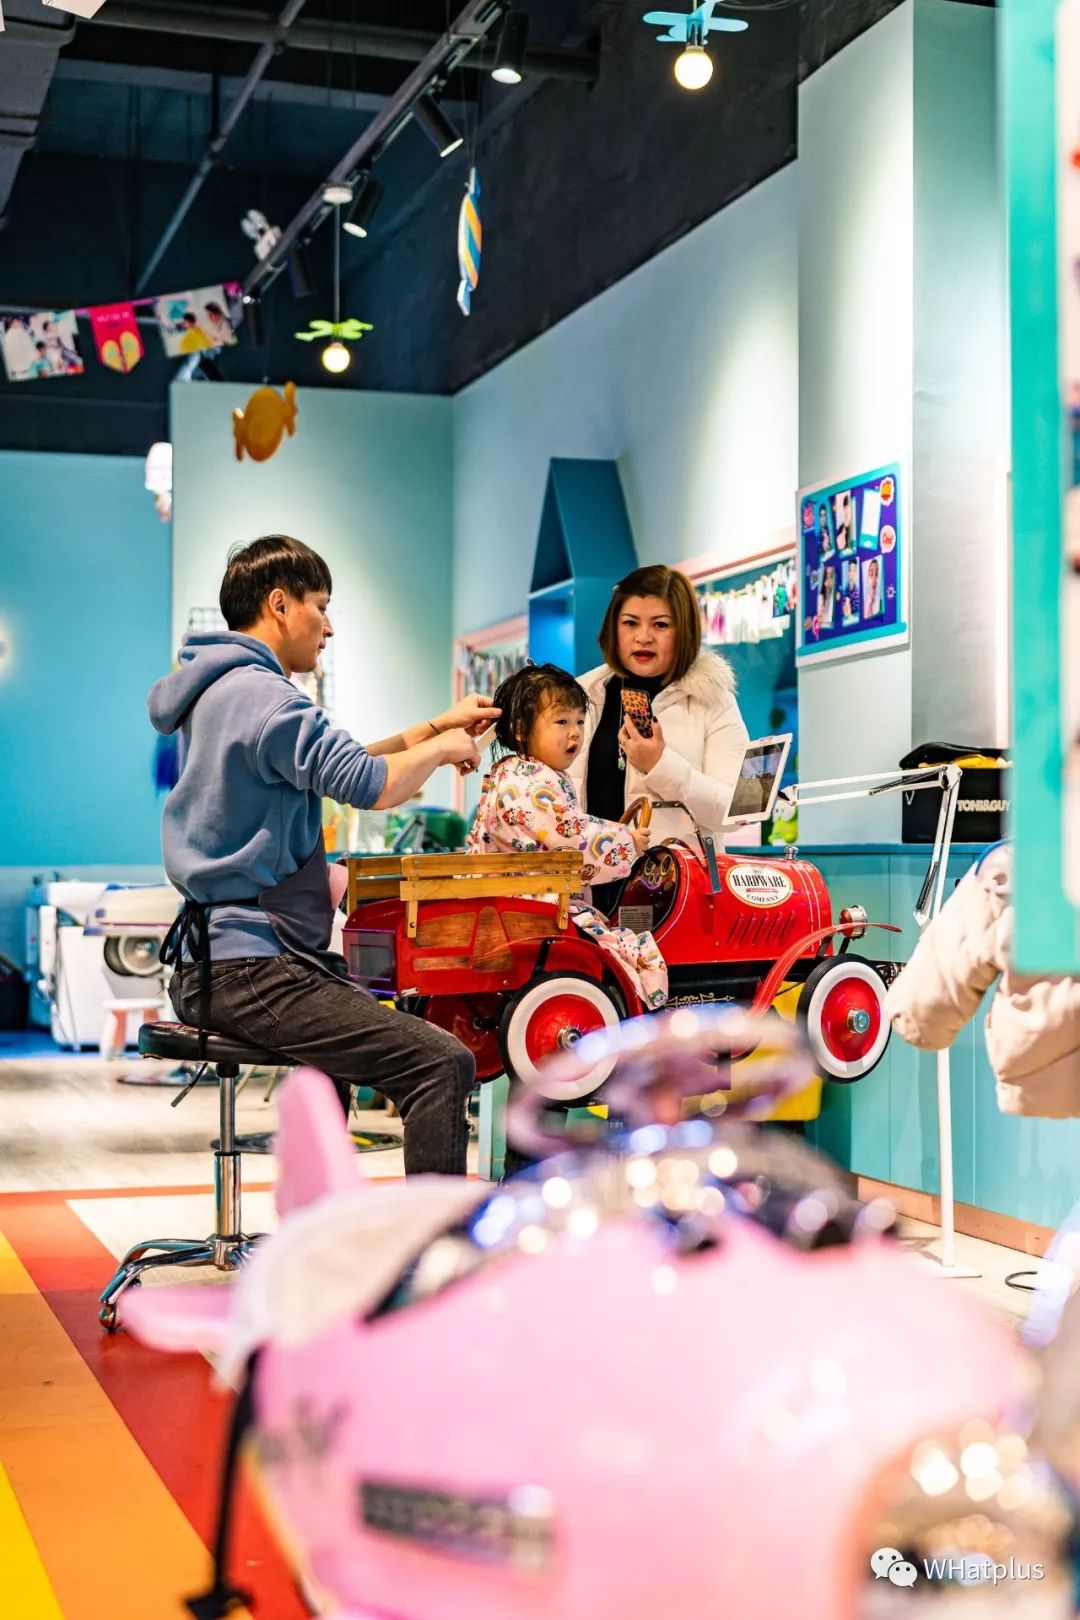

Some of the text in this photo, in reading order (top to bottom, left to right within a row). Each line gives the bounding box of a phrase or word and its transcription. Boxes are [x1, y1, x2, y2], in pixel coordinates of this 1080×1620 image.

[957, 799, 1011, 812] TONI&GUY
[732, 874, 787, 888] HARDWARE
[746, 893, 779, 903] COMPANY
